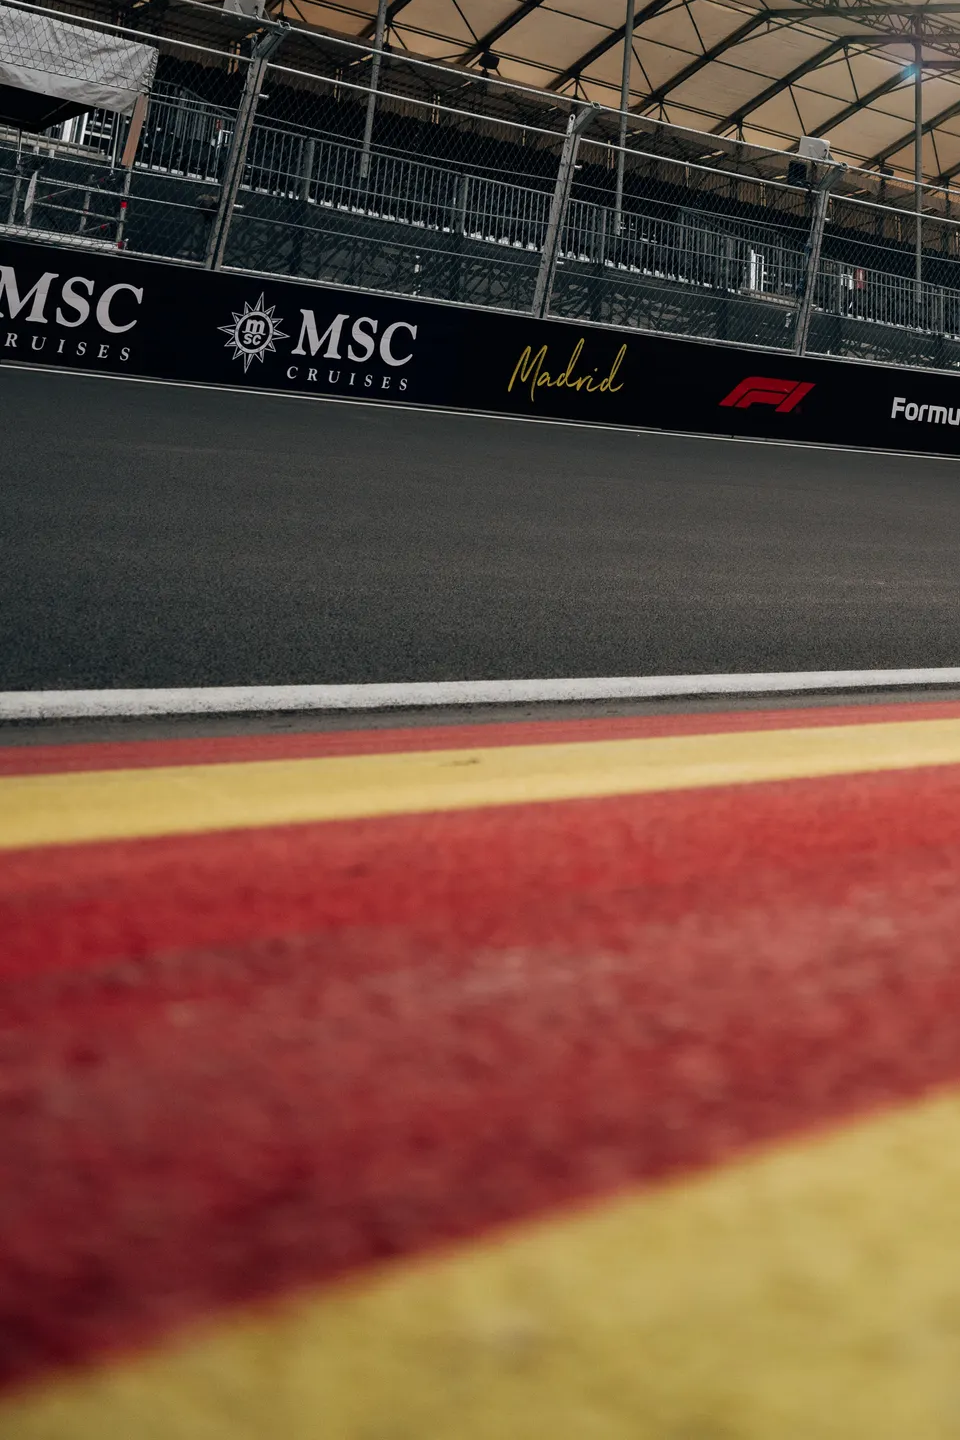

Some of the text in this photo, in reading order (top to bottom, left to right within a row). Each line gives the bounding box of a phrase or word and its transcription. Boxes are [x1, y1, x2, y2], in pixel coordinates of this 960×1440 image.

[0, 265, 144, 334] MSC
[3, 332, 131, 361] RUISES
[290, 309, 417, 366] MSC
[286, 366, 408, 391] CRUISES
[507, 338, 627, 401] Madrid
